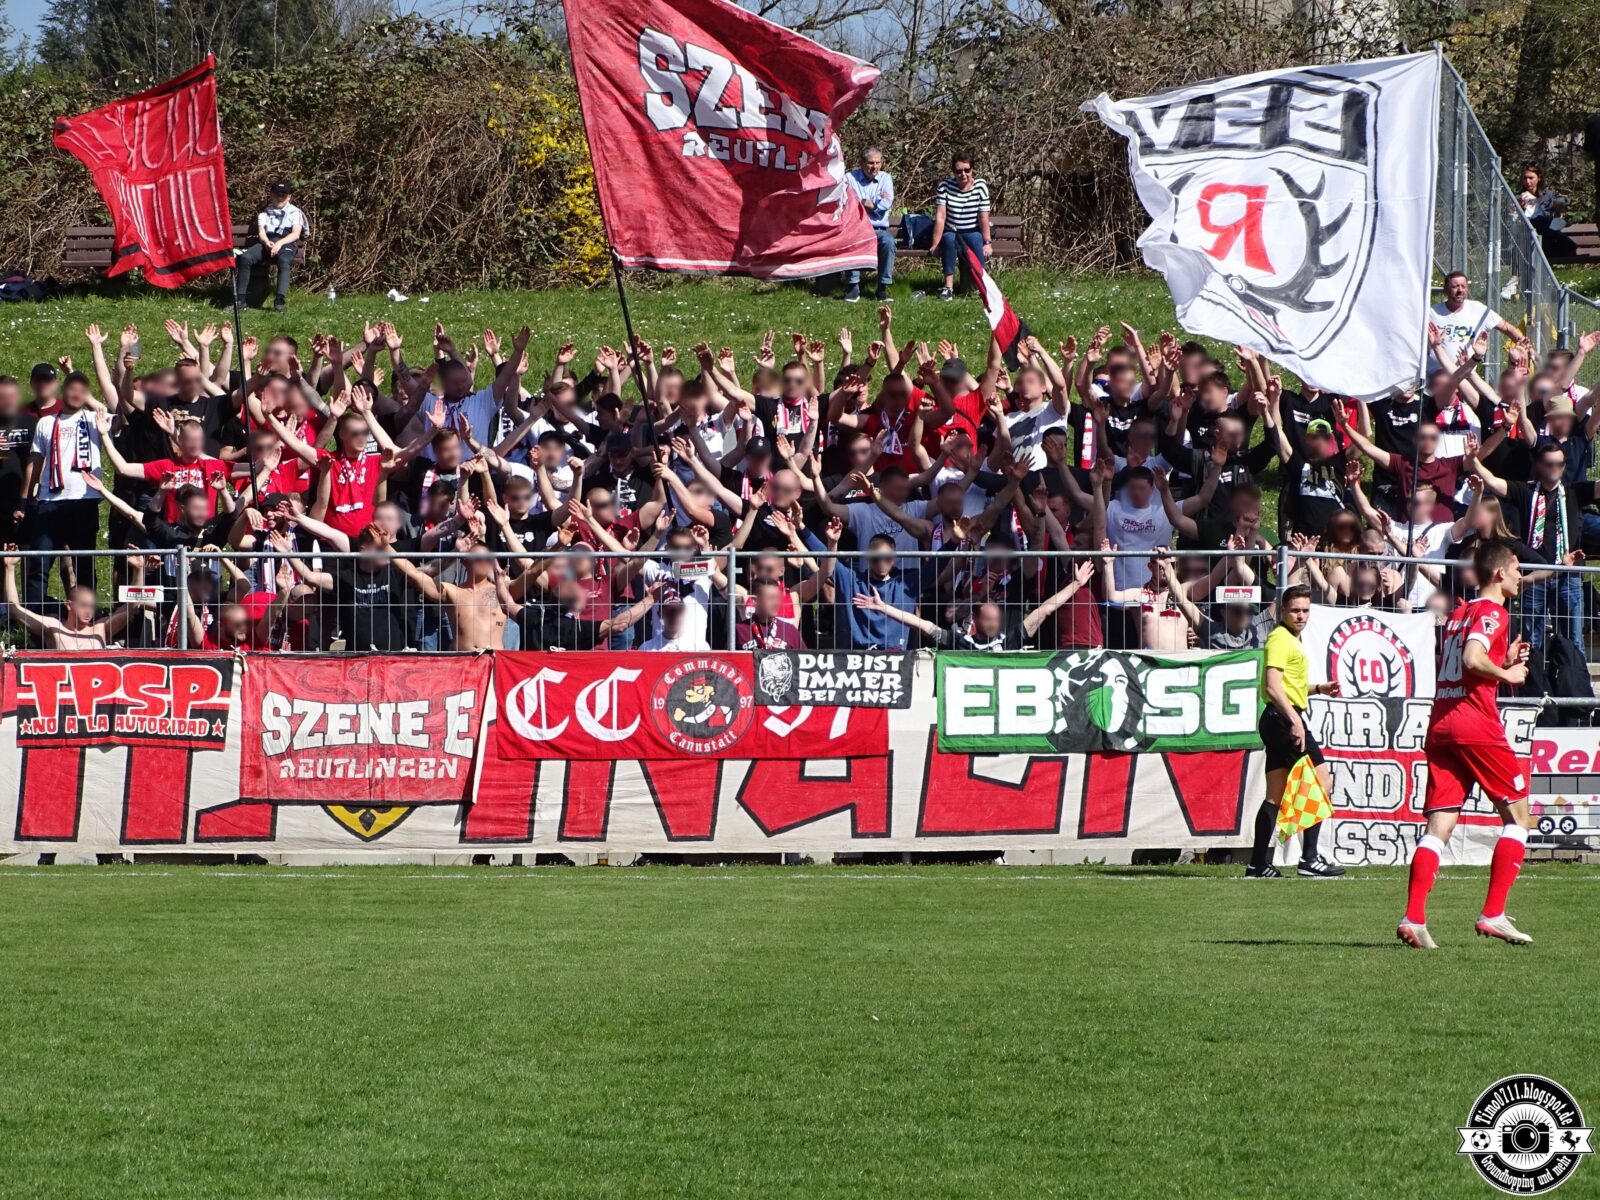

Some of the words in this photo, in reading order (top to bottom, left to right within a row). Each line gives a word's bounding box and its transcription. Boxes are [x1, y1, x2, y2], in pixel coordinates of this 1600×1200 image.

[664, 660, 743, 685] Commando
[798, 654, 835, 670] DU
[846, 654, 904, 671] BIST
[21, 662, 222, 719] TPSP
[798, 671, 903, 690] IMMER
[653, 697, 665, 710] 19
[740, 696, 753, 709] 97
[798, 689, 836, 701] BEI
[845, 690, 904, 704] UNS!
[31, 717, 58, 734] NO
[65, 716, 78, 734] A
[86, 715, 109, 732] LA
[115, 715, 210, 736] AUTORIDAD
[261, 690, 430, 757] SZENE
[444, 689, 475, 758] E
[669, 730, 737, 753] Cannstatt
[280, 757, 459, 779] REUTLINGEN
